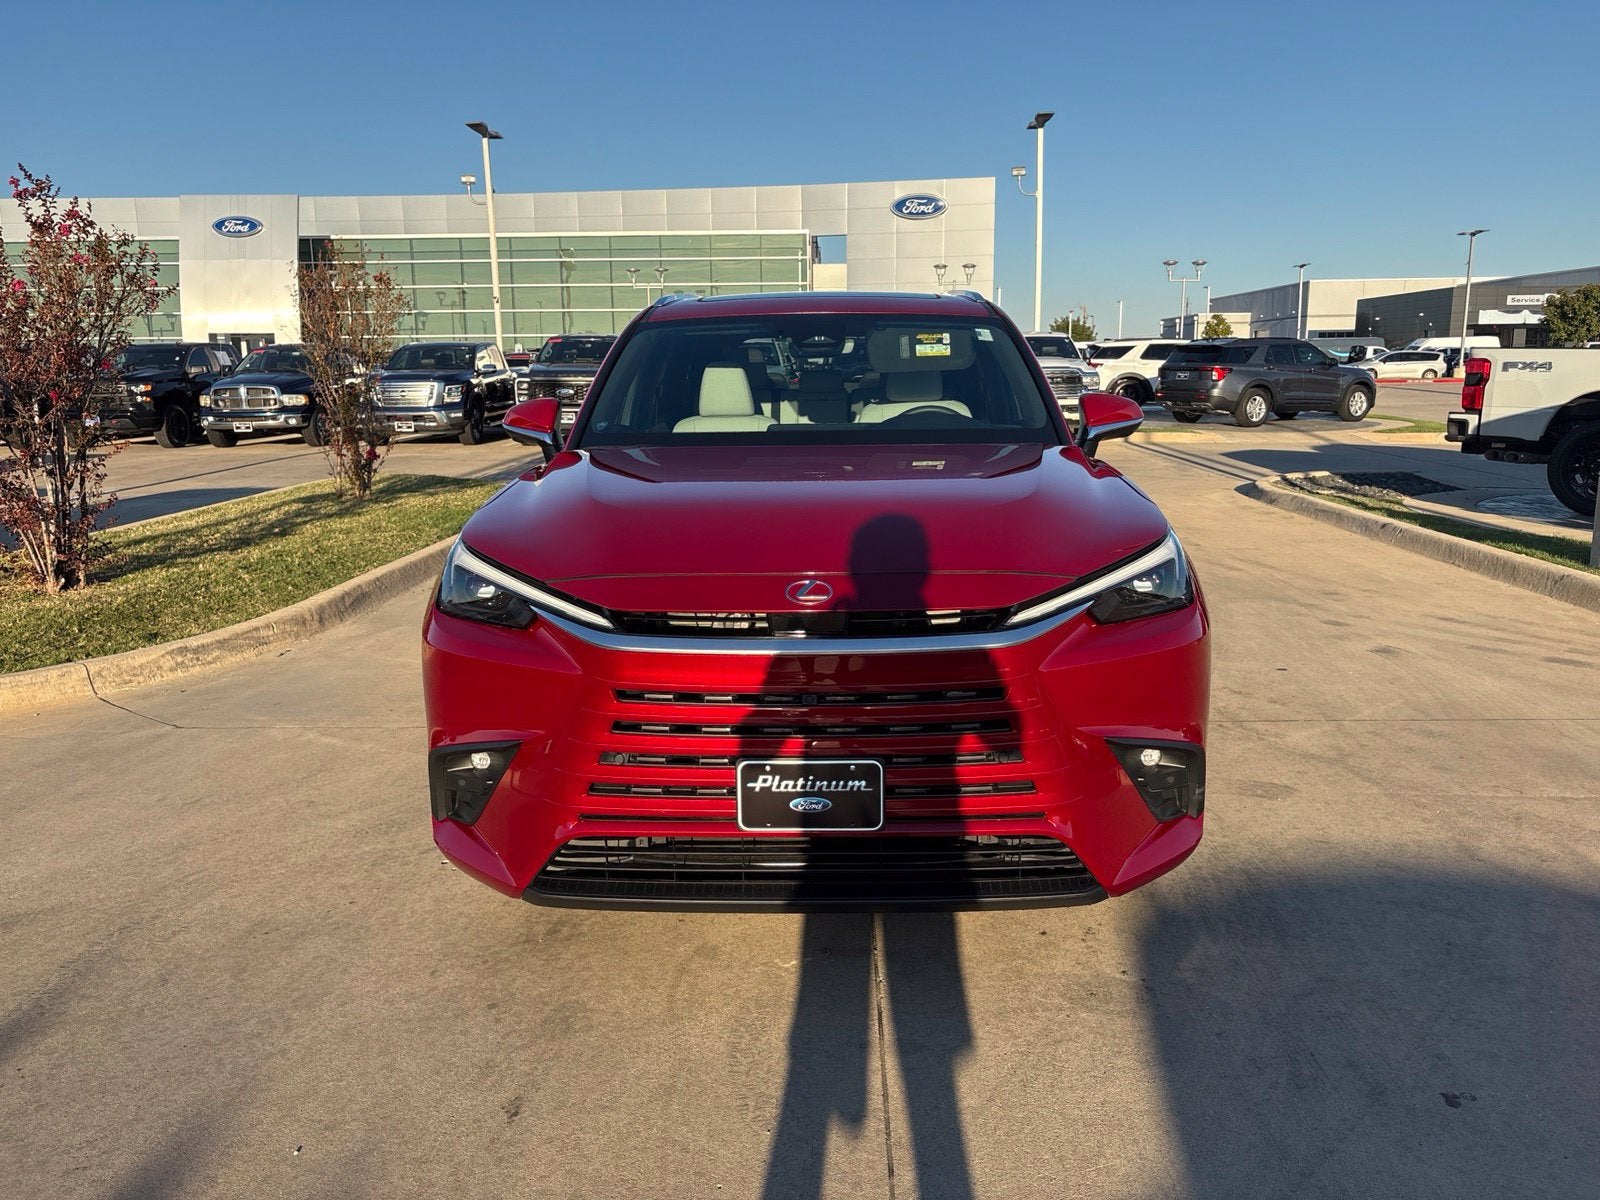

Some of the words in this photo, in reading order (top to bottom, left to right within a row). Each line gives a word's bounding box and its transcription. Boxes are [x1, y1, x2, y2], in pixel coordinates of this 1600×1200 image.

[902, 199, 935, 214] Ford
[221, 219, 251, 232] Ford
[1501, 361, 1553, 372] FX4
[746, 774, 874, 793] Platinum
[797, 799, 824, 811] Ford
